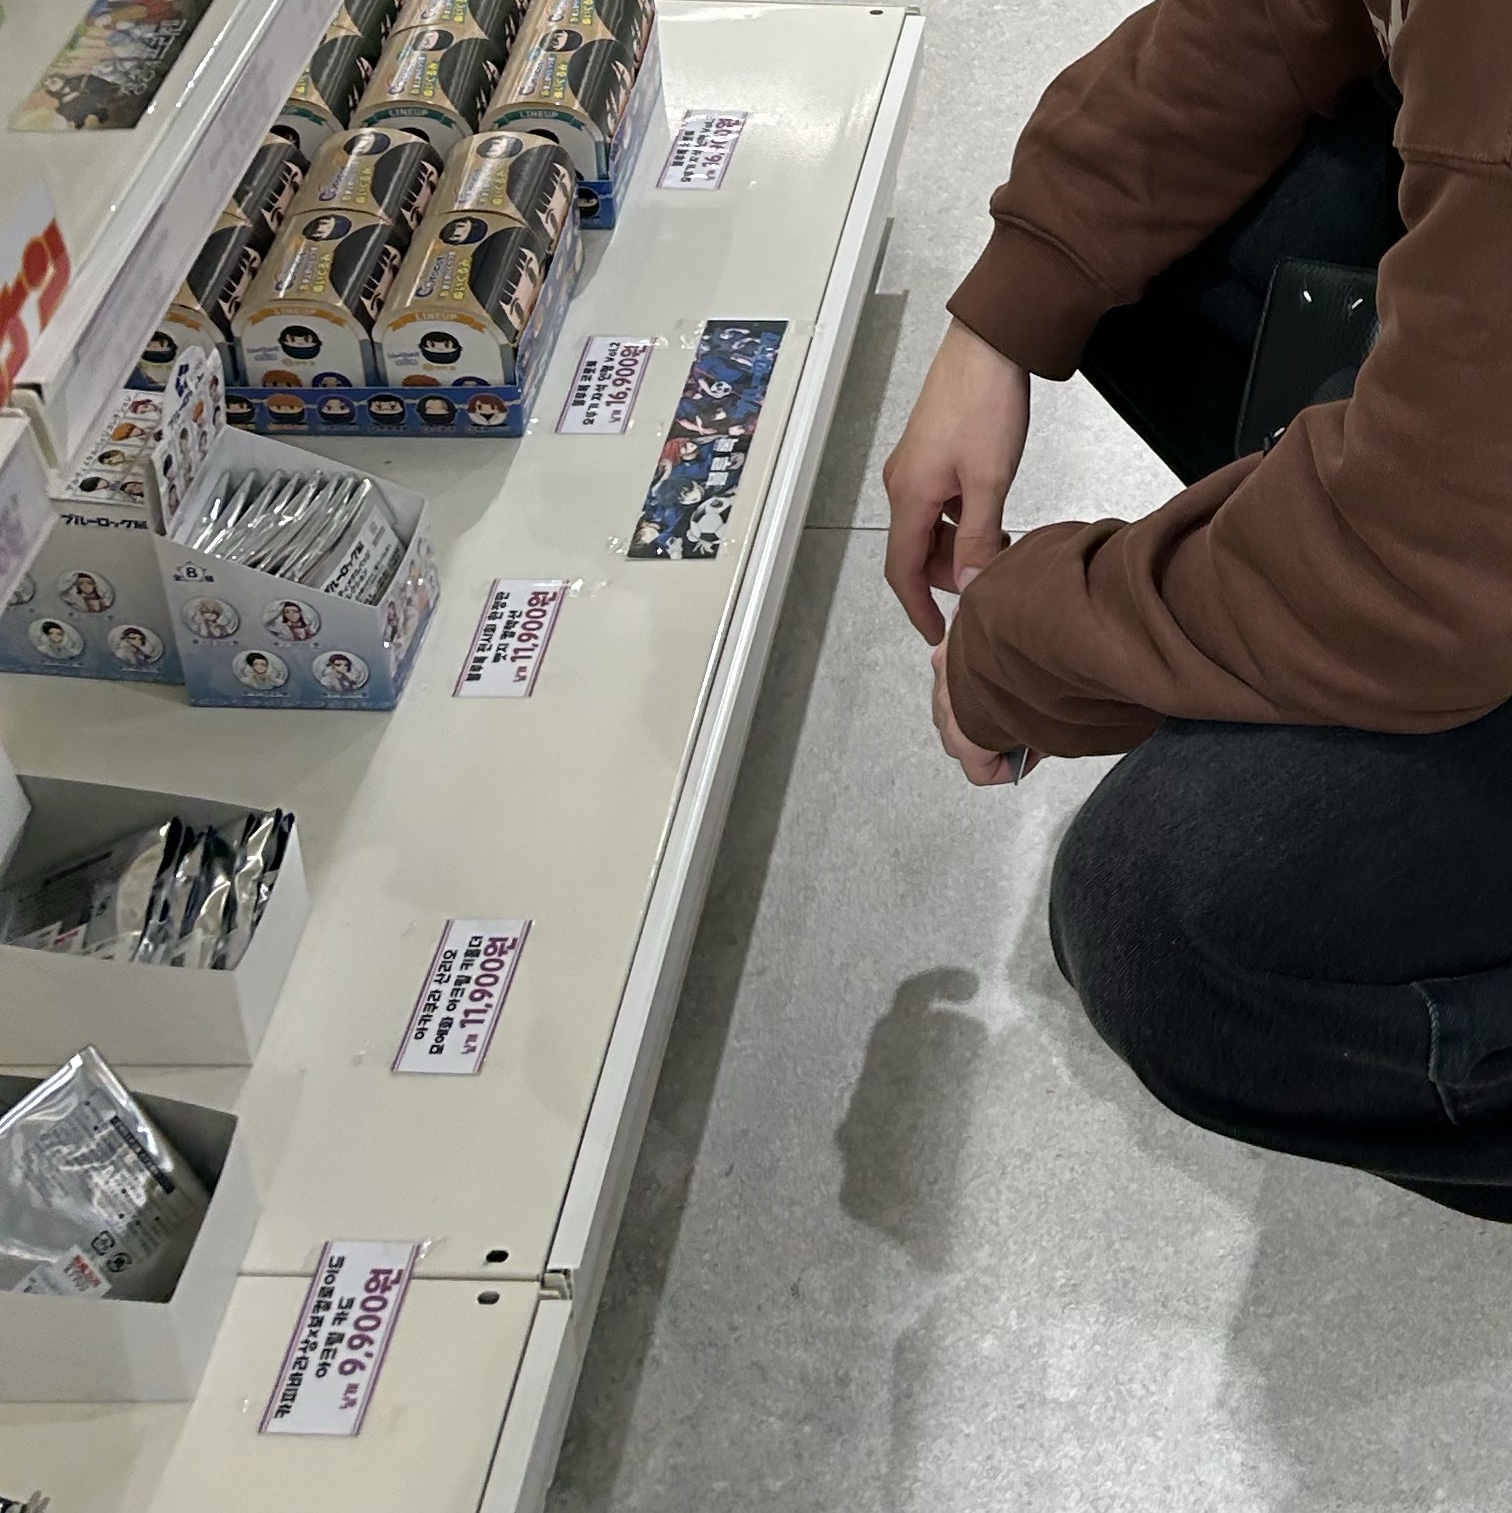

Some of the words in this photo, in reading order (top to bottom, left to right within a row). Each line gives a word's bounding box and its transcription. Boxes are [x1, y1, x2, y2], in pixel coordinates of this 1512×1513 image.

[388, 108, 429, 118] LINEUP
[591, 384, 608, 400] 자석
[603, 342, 620, 363] Vol.2
[605, 345, 647, 406] 16,900원
[476, 623, 497, 653] 전시회
[510, 592, 557, 663] 11,900원
[414, 990, 443, 1040] 아카쿠라
[433, 949, 458, 984] 산리오
[429, 1016, 455, 1055] 모에화
[445, 974, 472, 1011] 아크릴
[459, 935, 483, 971] 키홀더
[459, 936, 518, 1028] 11,900원
[314, 1331, 346, 1378] 아크릴
[331, 1295, 355, 1326] 카드
[337, 1268, 403, 1376] 9,900원
